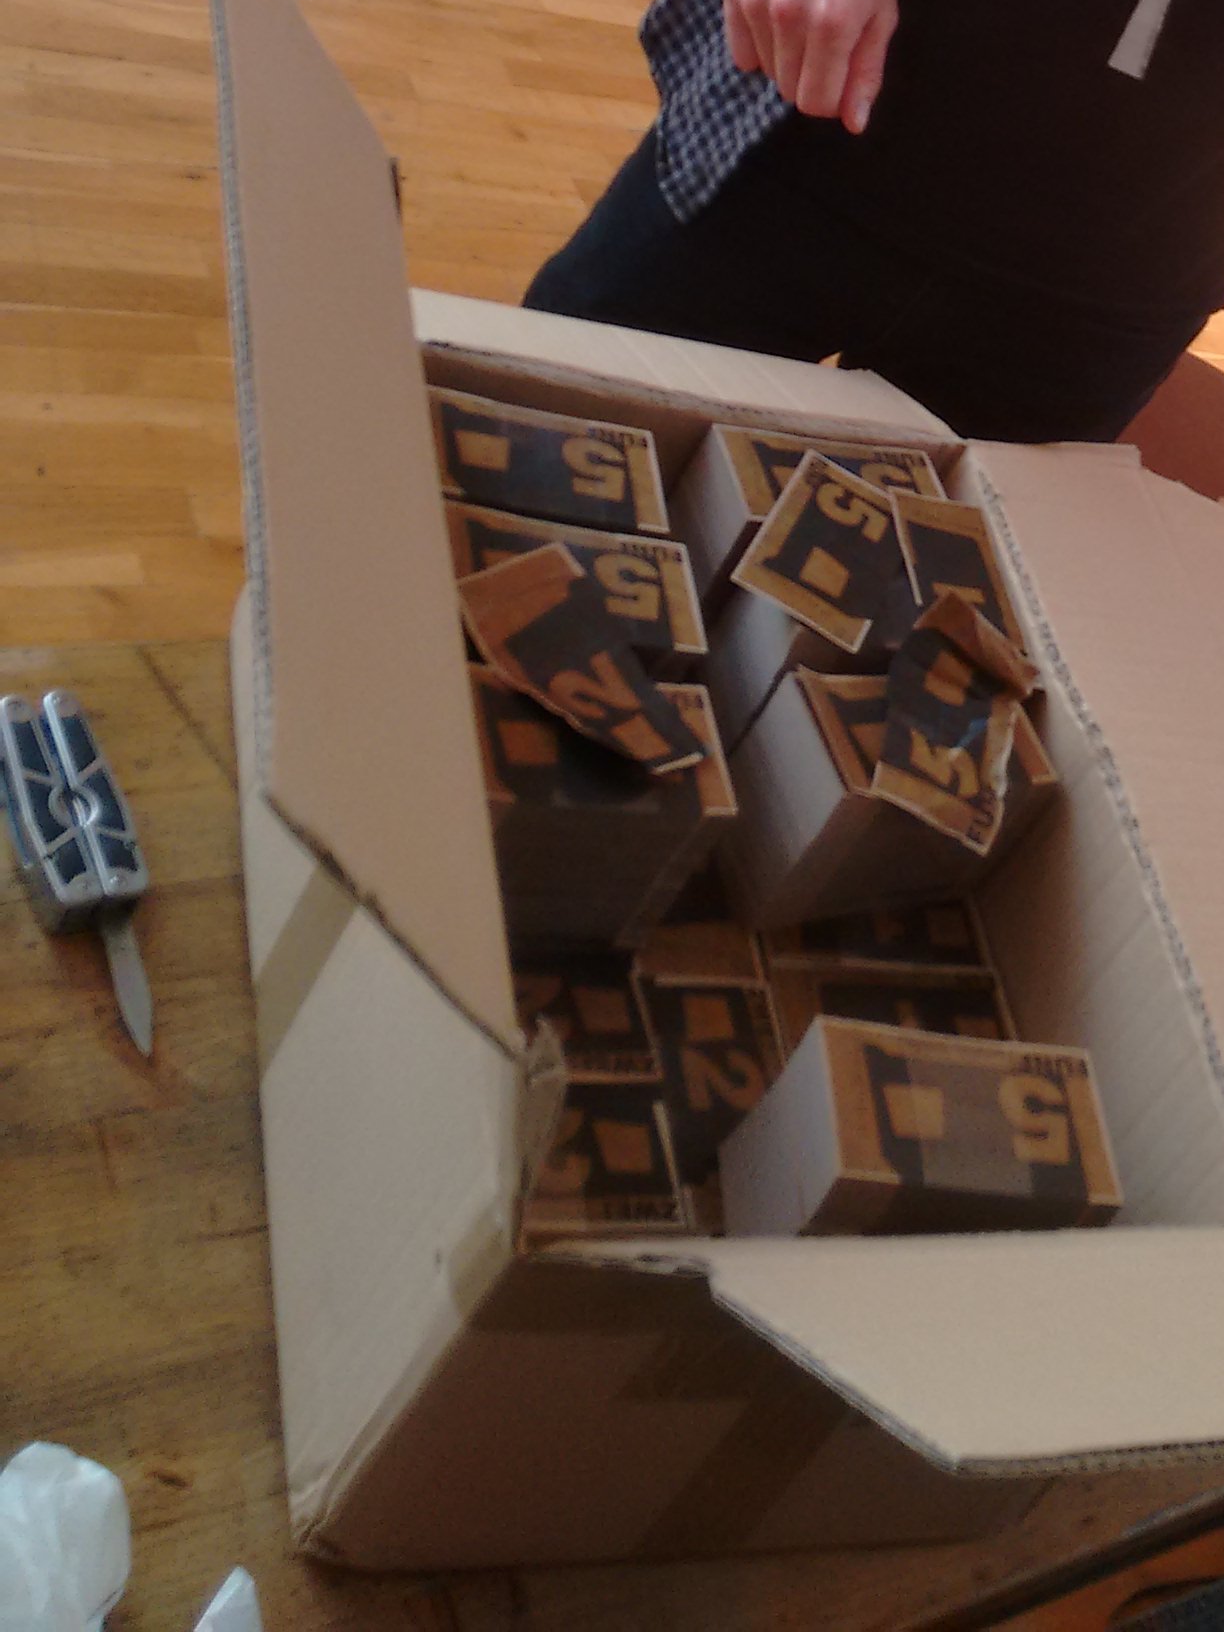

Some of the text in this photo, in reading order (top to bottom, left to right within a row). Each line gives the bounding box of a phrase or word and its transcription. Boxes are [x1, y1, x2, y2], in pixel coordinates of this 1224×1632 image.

[560, 436, 624, 501] 5
[815, 486, 887, 541] 5
[592, 552, 658, 621] 5
[550, 649, 638, 717] 2
[997, 1076, 1068, 1165] 5
